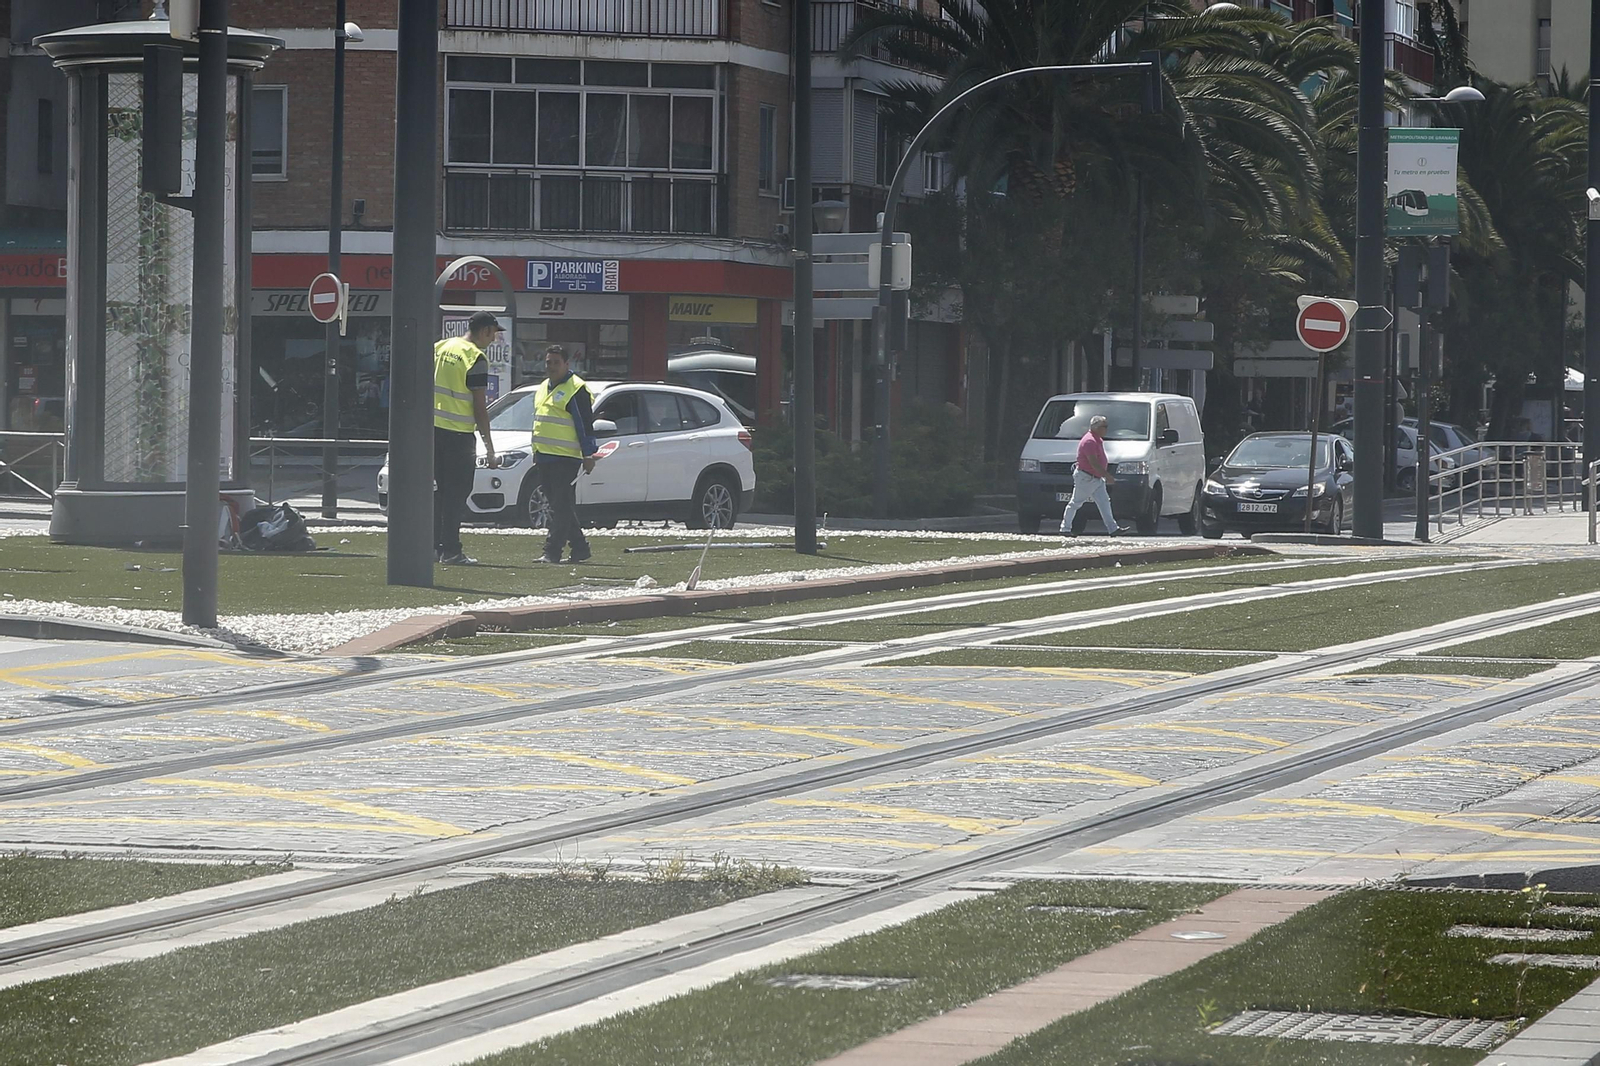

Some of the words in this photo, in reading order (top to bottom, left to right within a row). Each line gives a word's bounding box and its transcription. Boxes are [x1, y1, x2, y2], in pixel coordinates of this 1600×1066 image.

[554, 261, 602, 274] PARKING
[532, 263, 548, 287] P
[604, 261, 617, 291] GRATIS
[540, 297, 567, 311] BH
[670, 302, 714, 316] MAVIC
[1262, 504, 1277, 512] GYZ
